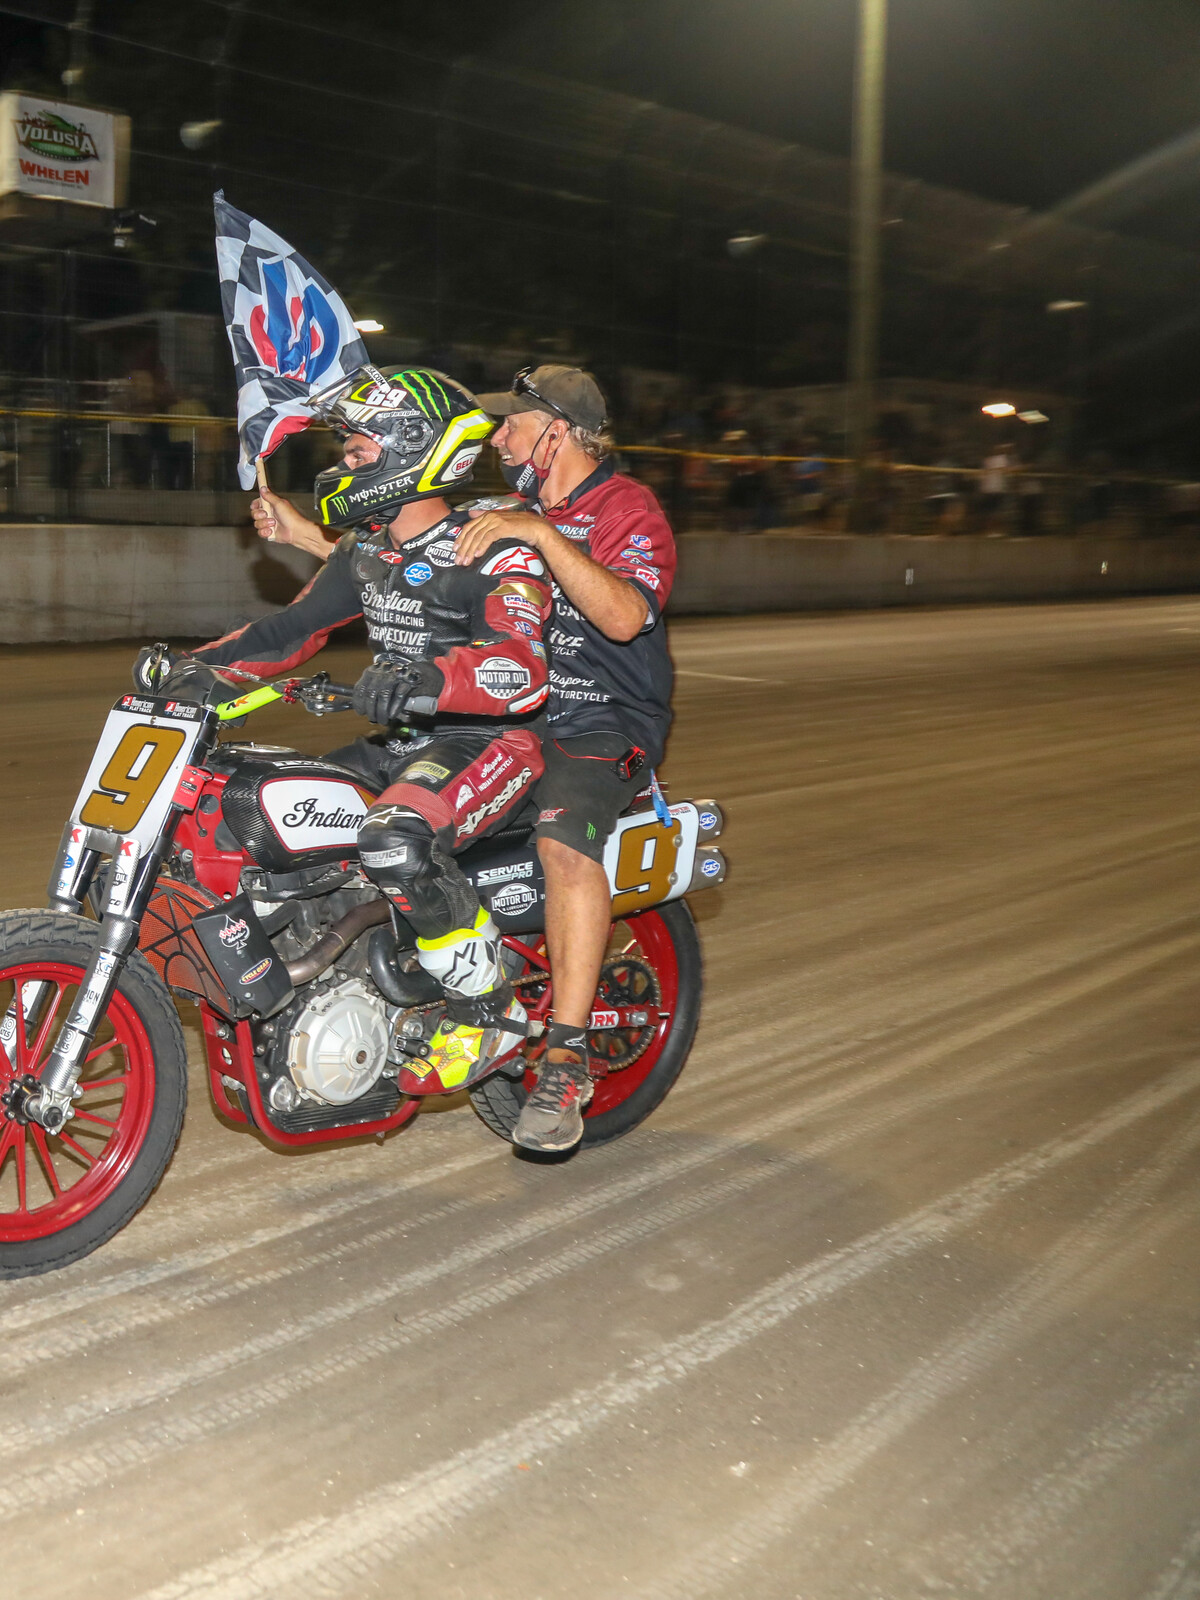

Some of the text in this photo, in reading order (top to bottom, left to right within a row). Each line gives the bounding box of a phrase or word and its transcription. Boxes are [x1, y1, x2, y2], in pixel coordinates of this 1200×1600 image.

[15, 122, 95, 156] VOLUSIA
[19, 158, 90, 186] WHELEN
[365, 387, 408, 408] 69
[455, 457, 474, 472] BELL
[349, 475, 415, 503] MONSTER
[363, 488, 409, 507] ENERGY
[428, 546, 450, 559] MOTOR
[361, 581, 423, 615] Indian
[395, 613, 425, 628] RACING
[479, 671, 528, 684] MOTOR OIL
[131, 696, 155, 709] American
[174, 702, 198, 715] American
[491, 755, 514, 781] MOTORCYCLE
[79, 722, 187, 835] 9
[282, 798, 365, 830] Indian
[360, 847, 406, 861] SERVICE
[477, 861, 534, 882] SERVICE
[511, 869, 534, 880] PRO
[609, 817, 682, 919] 9
[494, 894, 522, 908] MOTOR
[522, 892, 535, 902] OIL
[594, 1013, 617, 1027] RK
[445, 1039, 465, 1060] 9
